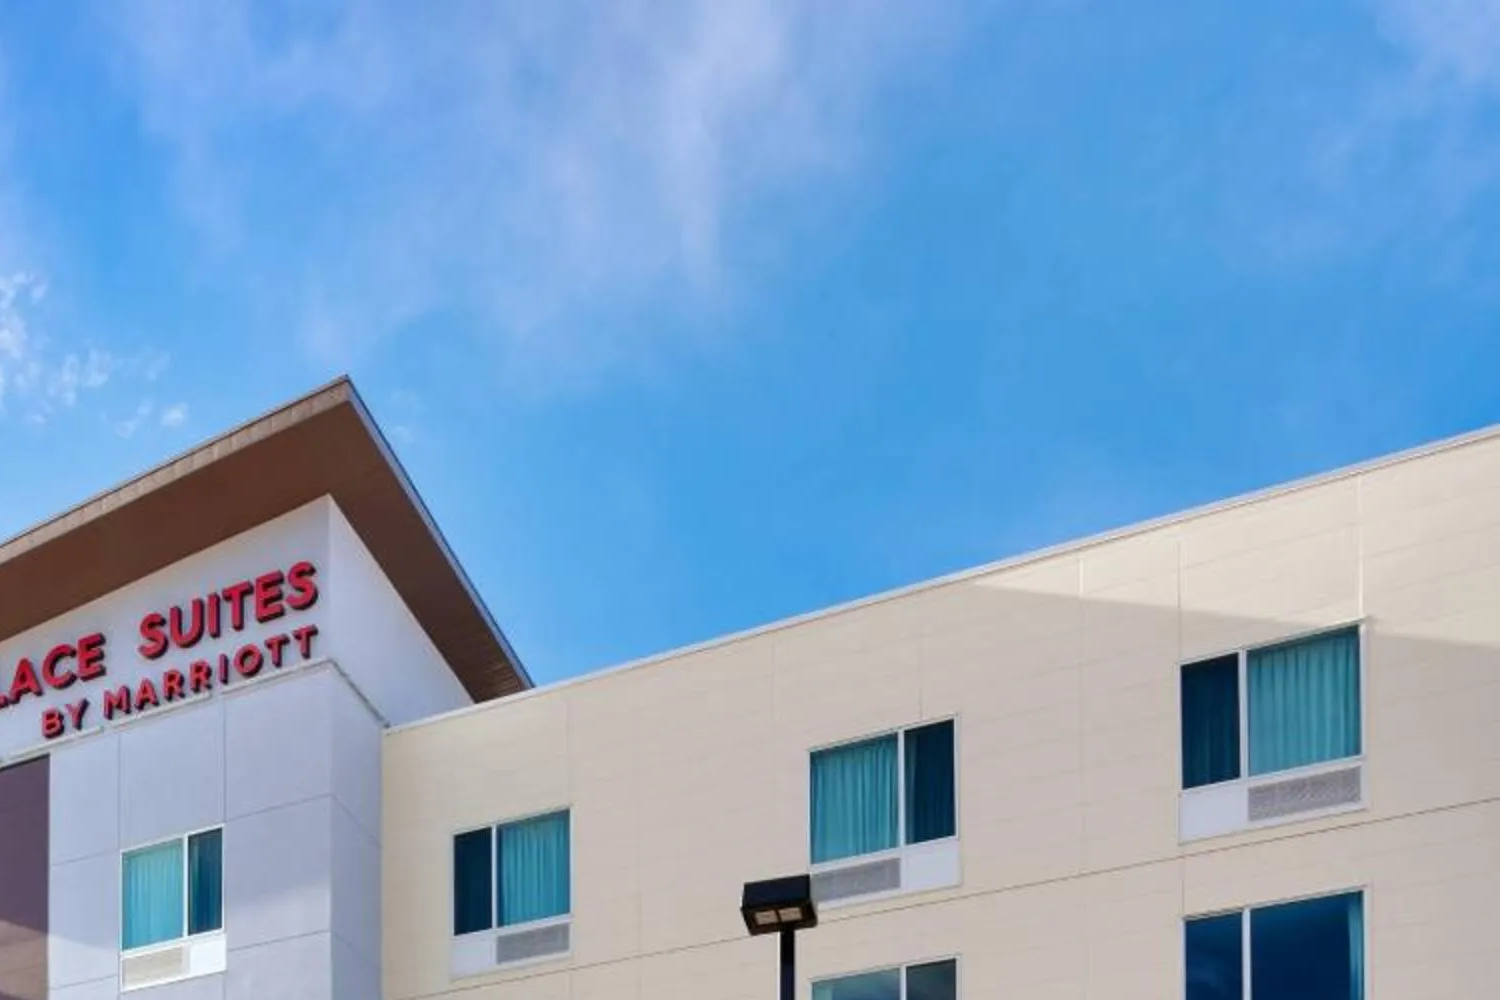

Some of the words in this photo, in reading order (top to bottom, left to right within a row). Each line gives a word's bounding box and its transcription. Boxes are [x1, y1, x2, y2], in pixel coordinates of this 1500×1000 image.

[137, 560, 319, 660] SUITES
[41, 697, 89, 739] BY
[103, 623, 319, 721] MARRIOTT
